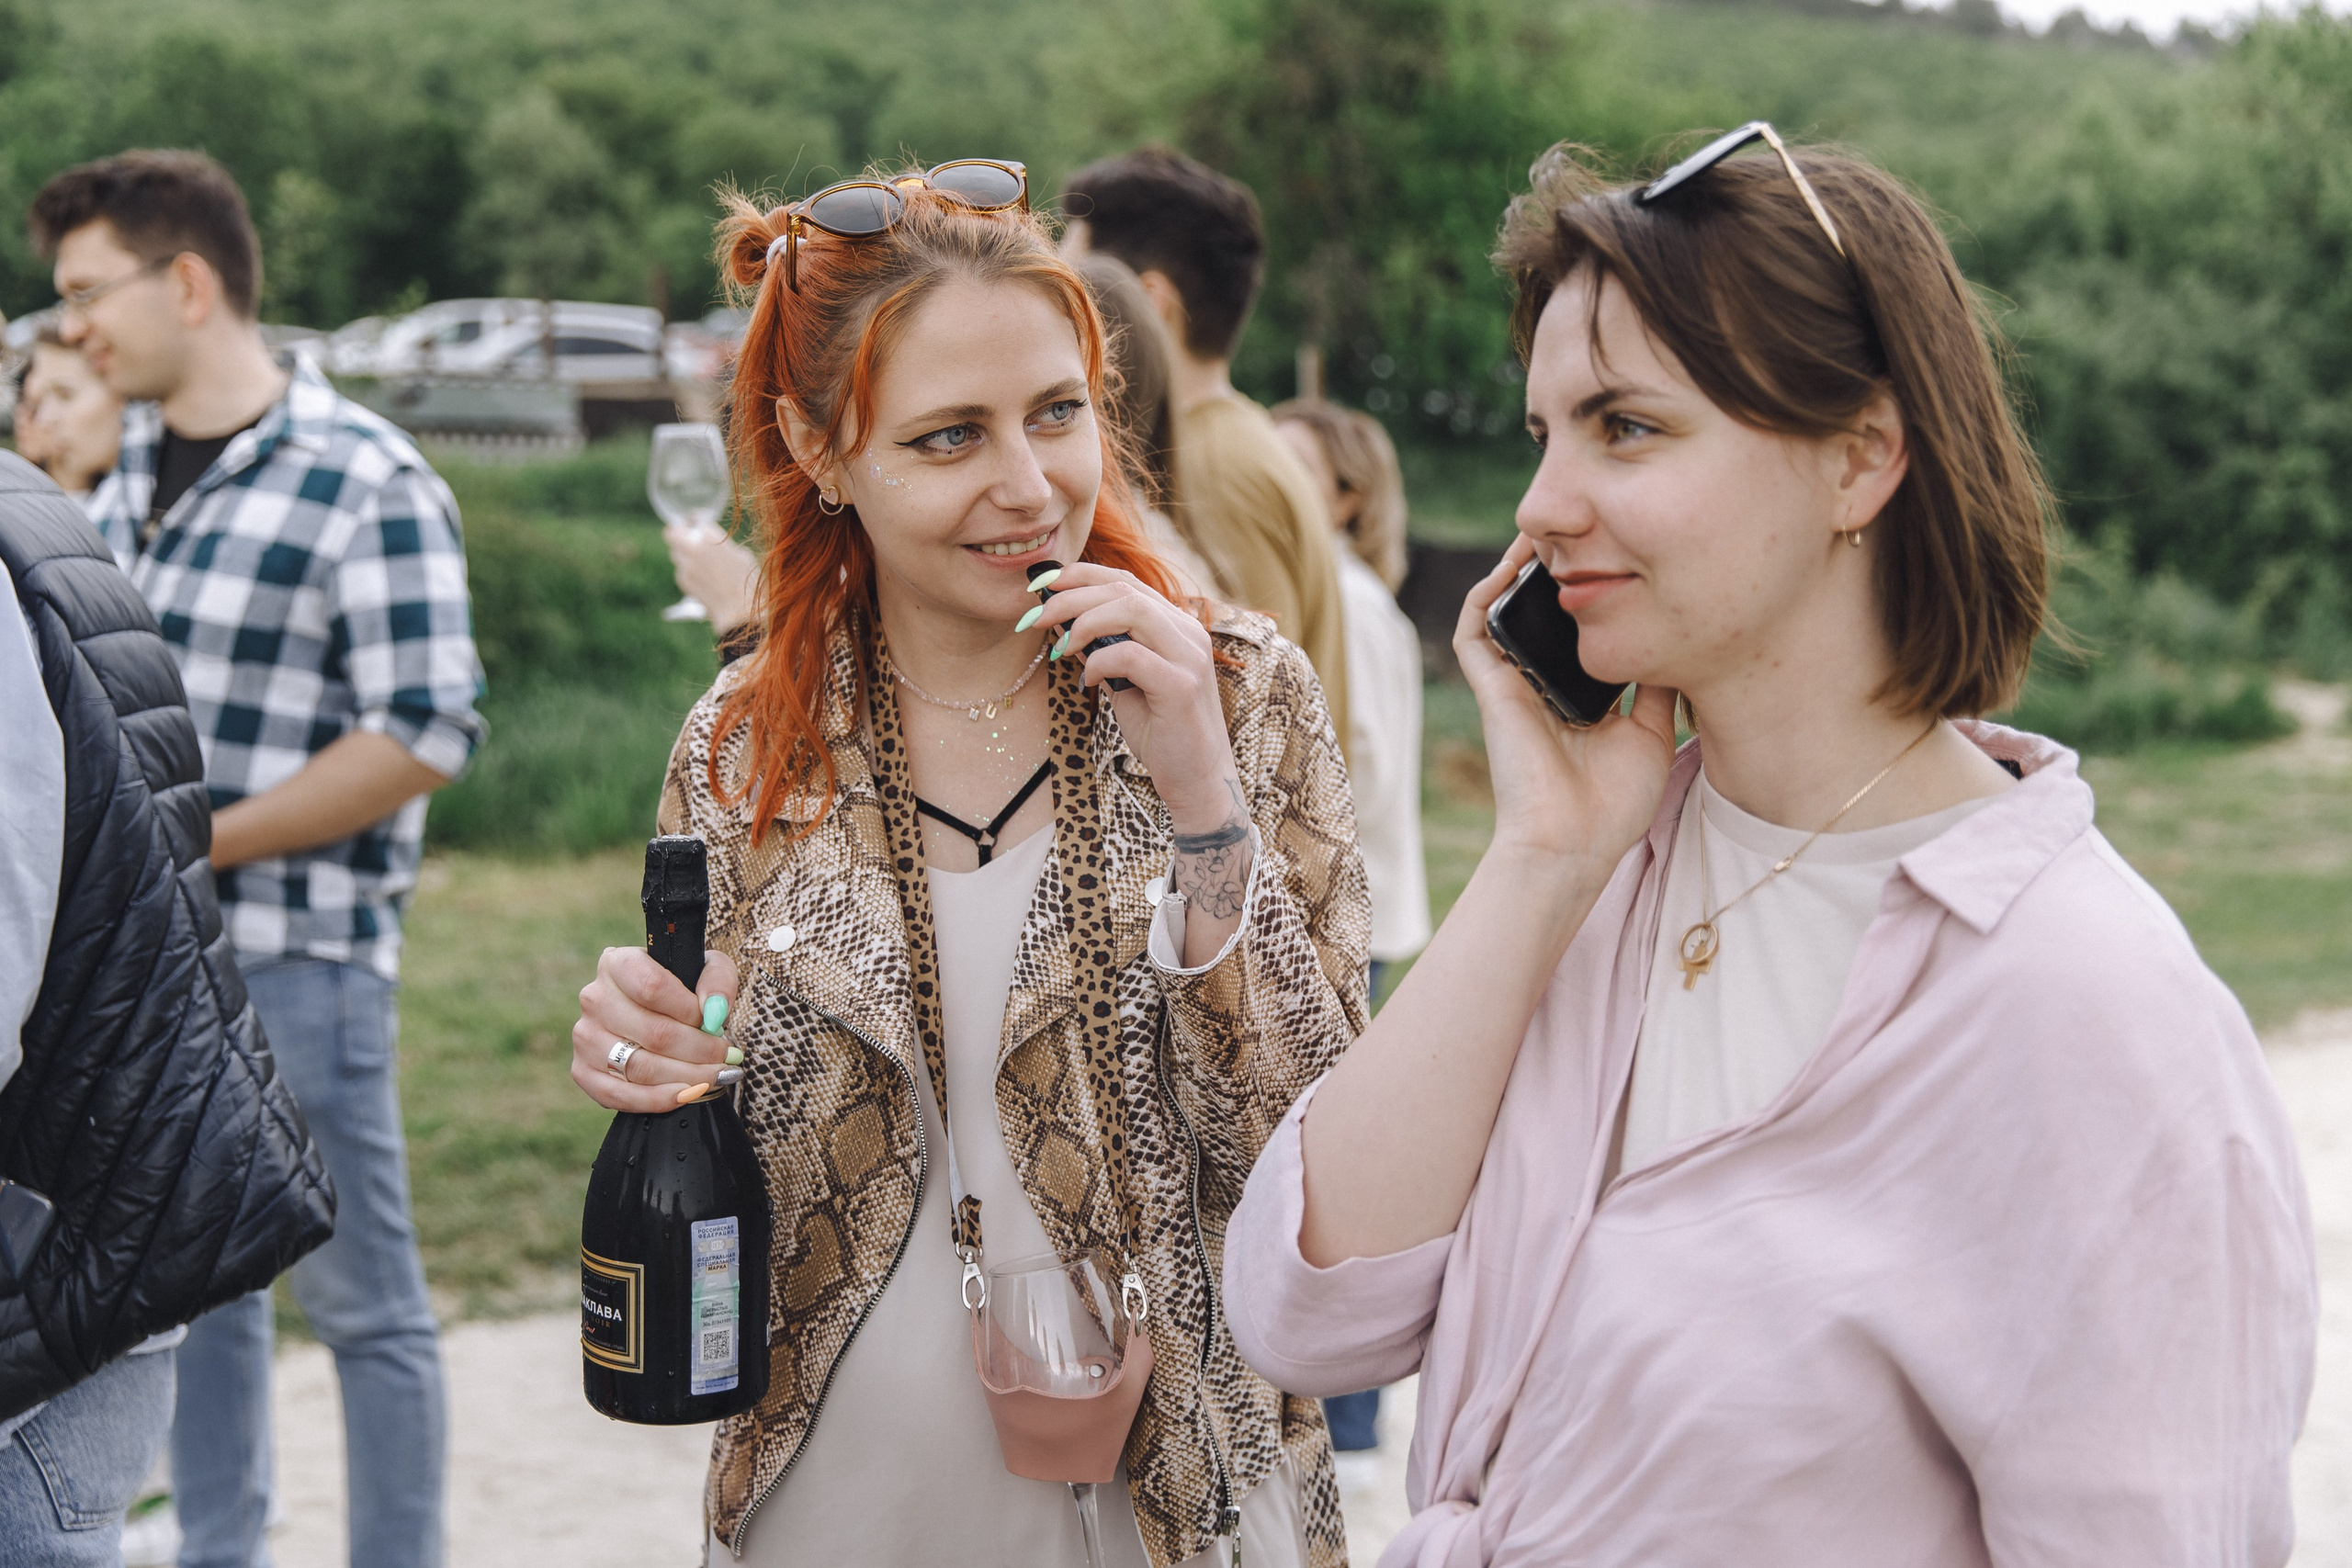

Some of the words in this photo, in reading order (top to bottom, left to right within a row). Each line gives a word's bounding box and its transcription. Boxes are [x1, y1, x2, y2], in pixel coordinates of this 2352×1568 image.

[697, 1224, 734, 1234] РОССИЙСКАЯ
[698, 1229, 734, 1239] ФЕДЕРАЦИЯ
[696, 1252, 736, 1262] ФЕДЕРАЛЬНАЯ
[696, 1258, 736, 1268] СПЕЦИАЛЬНАЯ
